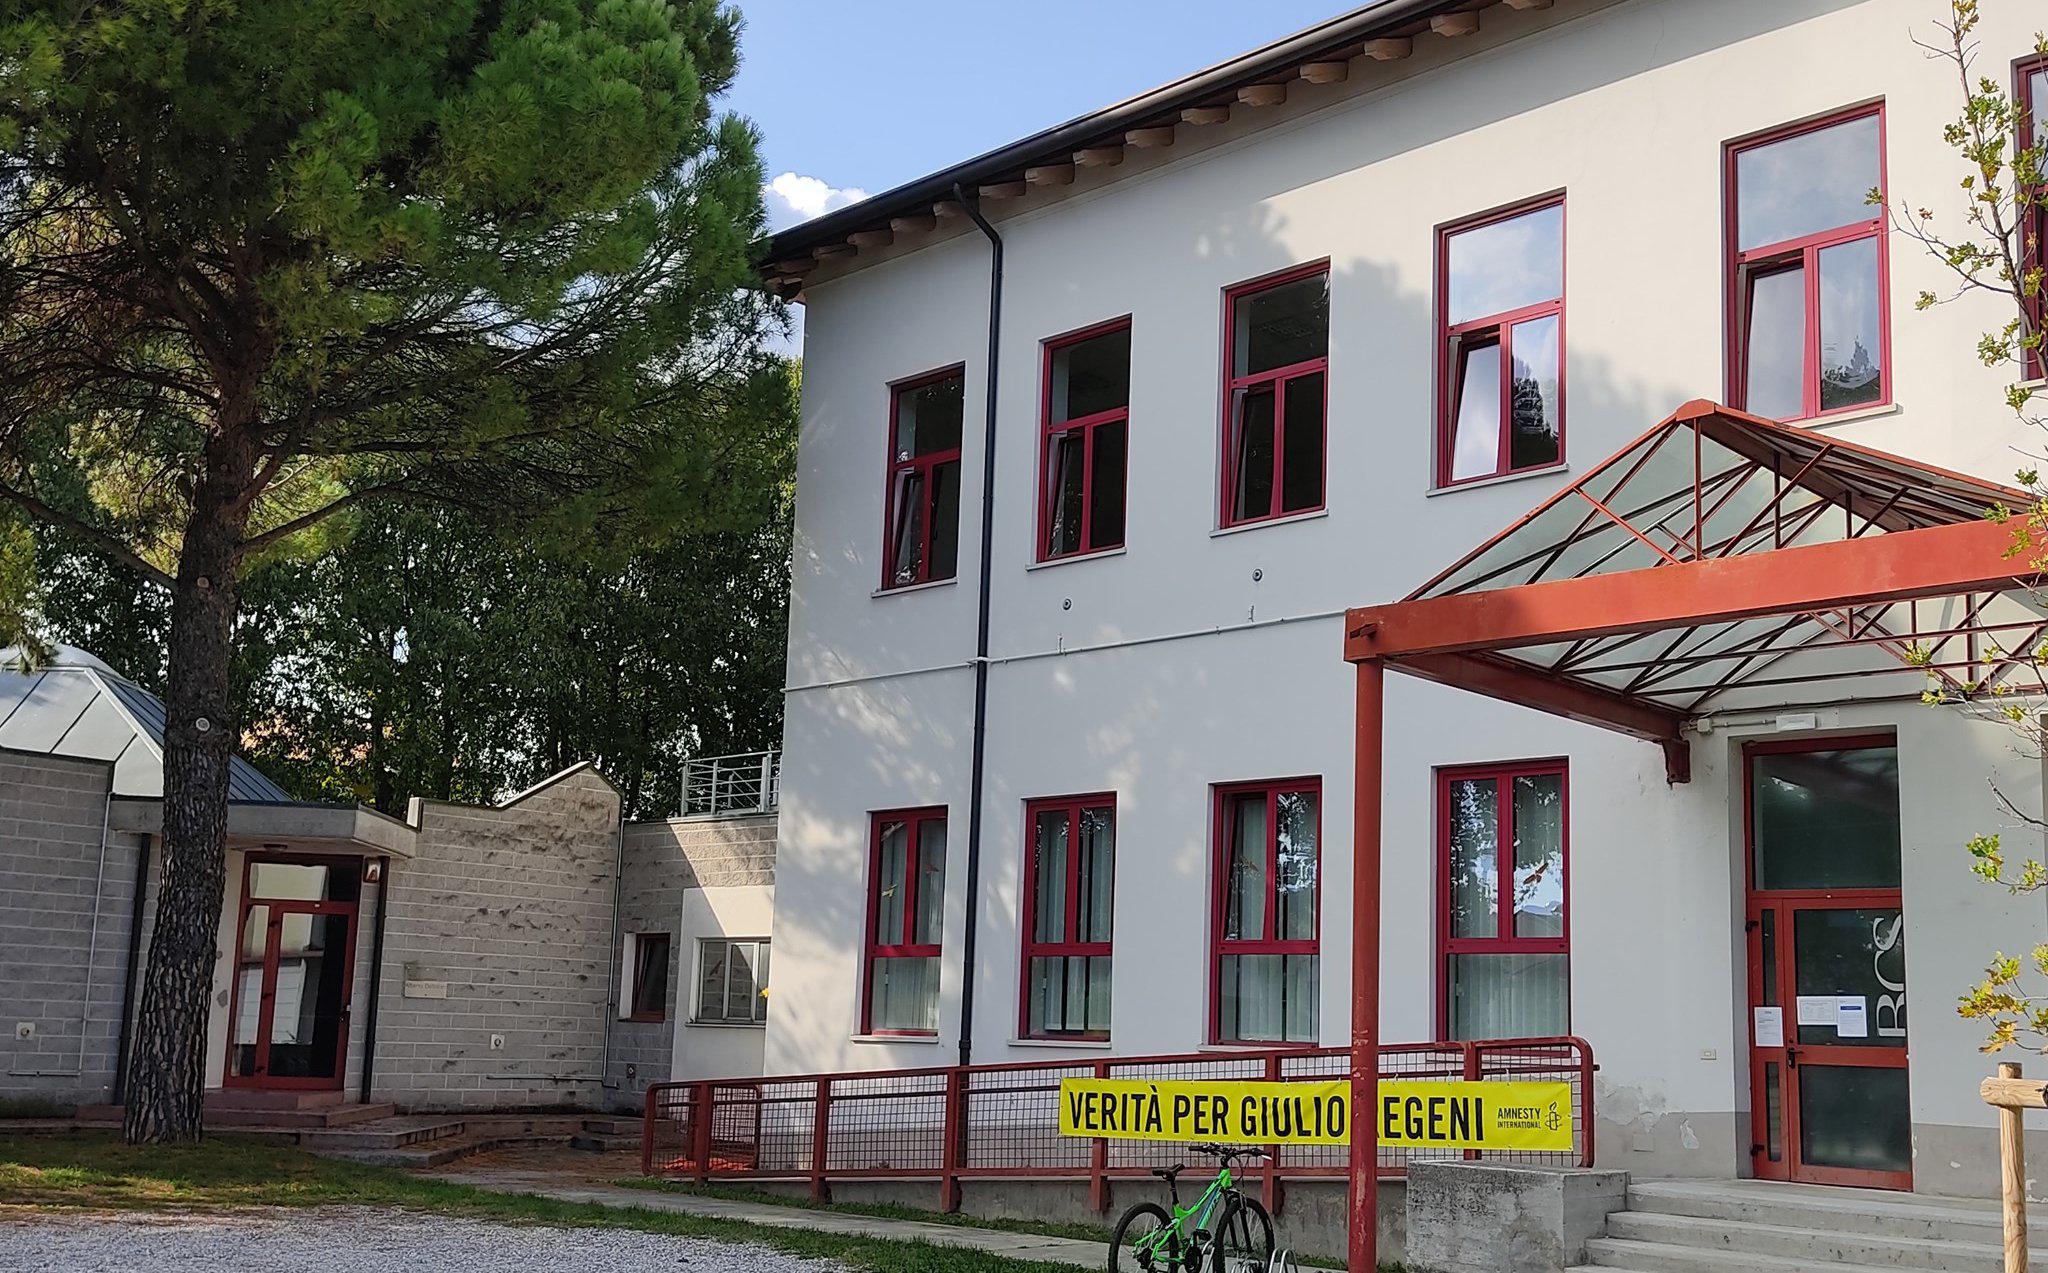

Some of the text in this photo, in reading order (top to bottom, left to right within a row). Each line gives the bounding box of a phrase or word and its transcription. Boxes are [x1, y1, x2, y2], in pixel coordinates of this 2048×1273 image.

[1069, 1085, 1484, 1141] VERITÀ PER GIULIO EGENI
[1497, 1107, 1541, 1120] AMNESTY
[1497, 1120, 1542, 1129] INTERNATIONAL
